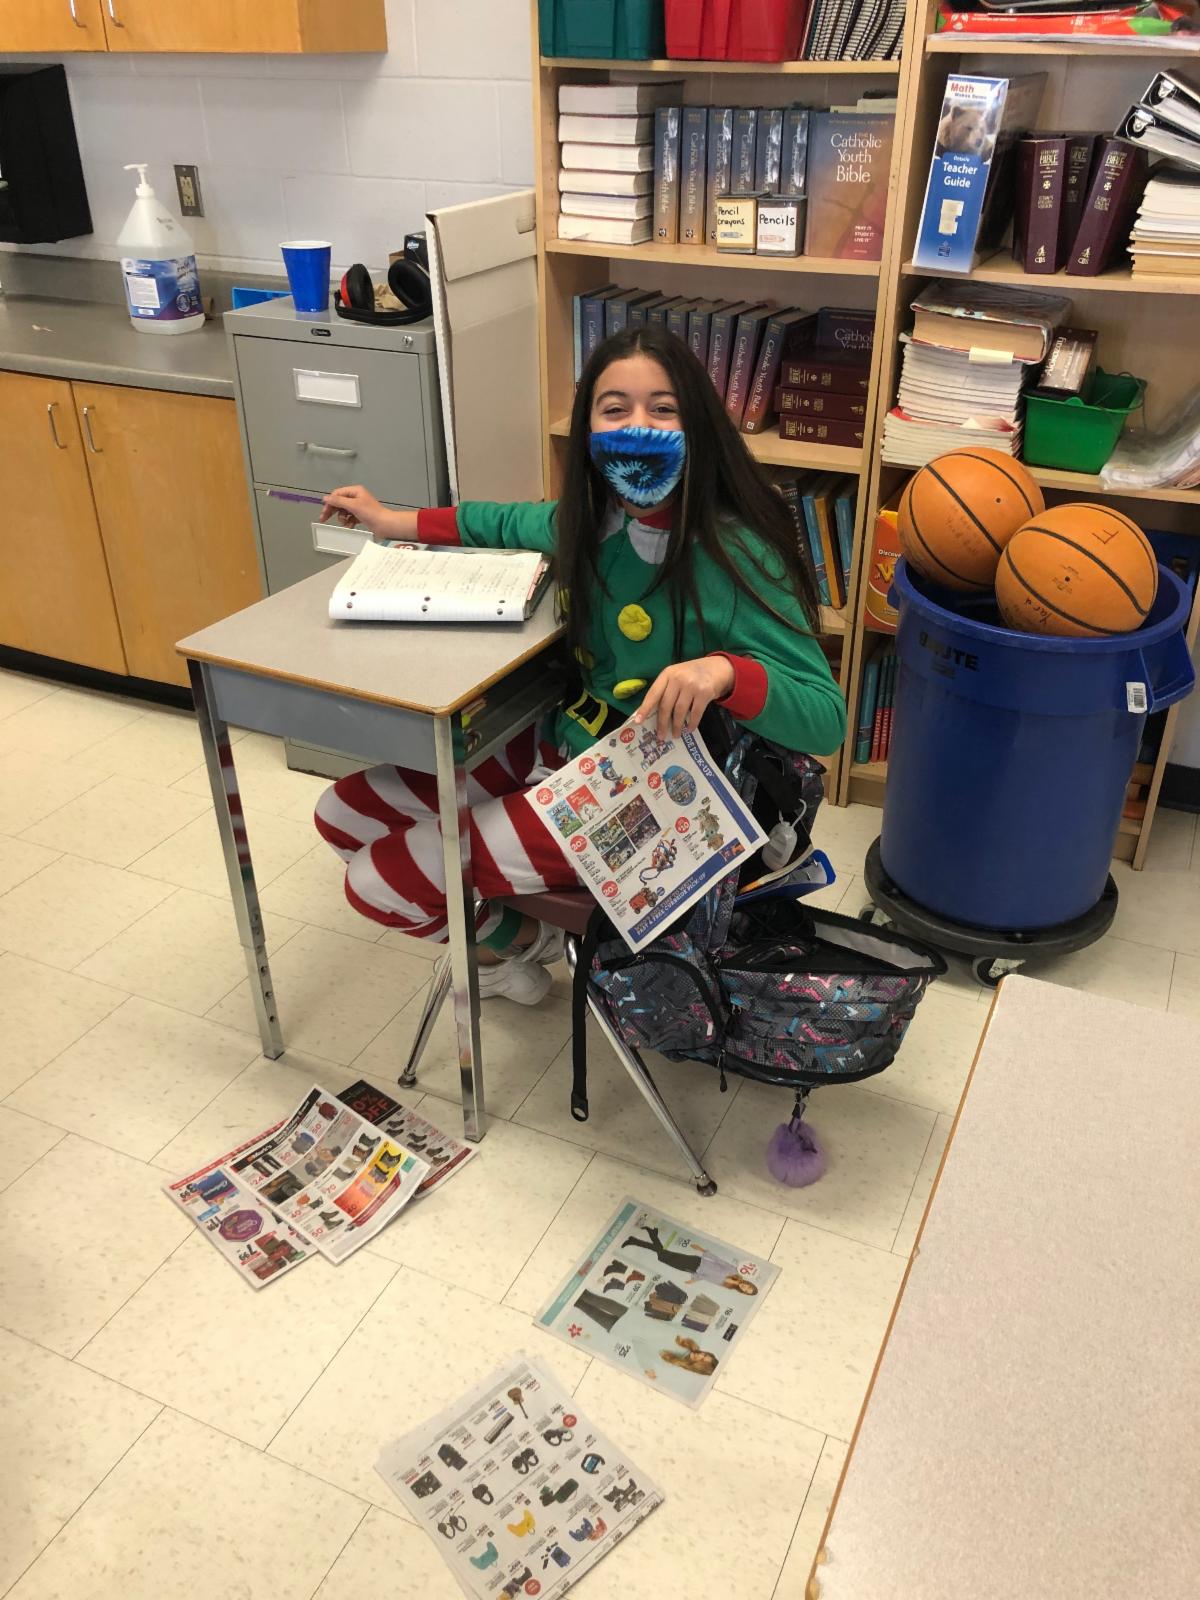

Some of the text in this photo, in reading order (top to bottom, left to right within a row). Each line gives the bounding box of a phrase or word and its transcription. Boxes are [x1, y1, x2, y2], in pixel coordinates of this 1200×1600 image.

[951, 82, 974, 93] Math
[830, 133, 882, 149] Catholic
[838, 150, 872, 164] Youth
[836, 164, 871, 183] Bible
[943, 162, 978, 175] Teacher
[944, 176, 971, 188] Guide
[718, 206, 739, 216] Pencil
[718, 218, 745, 228] crayons
[759, 214, 795, 226] Pencils
[835, 328, 873, 341] Cathol
[690, 746, 714, 777] PICK-UP
[739, 1262, 756, 1276] $16
[618, 1344, 631, 1358] $25
